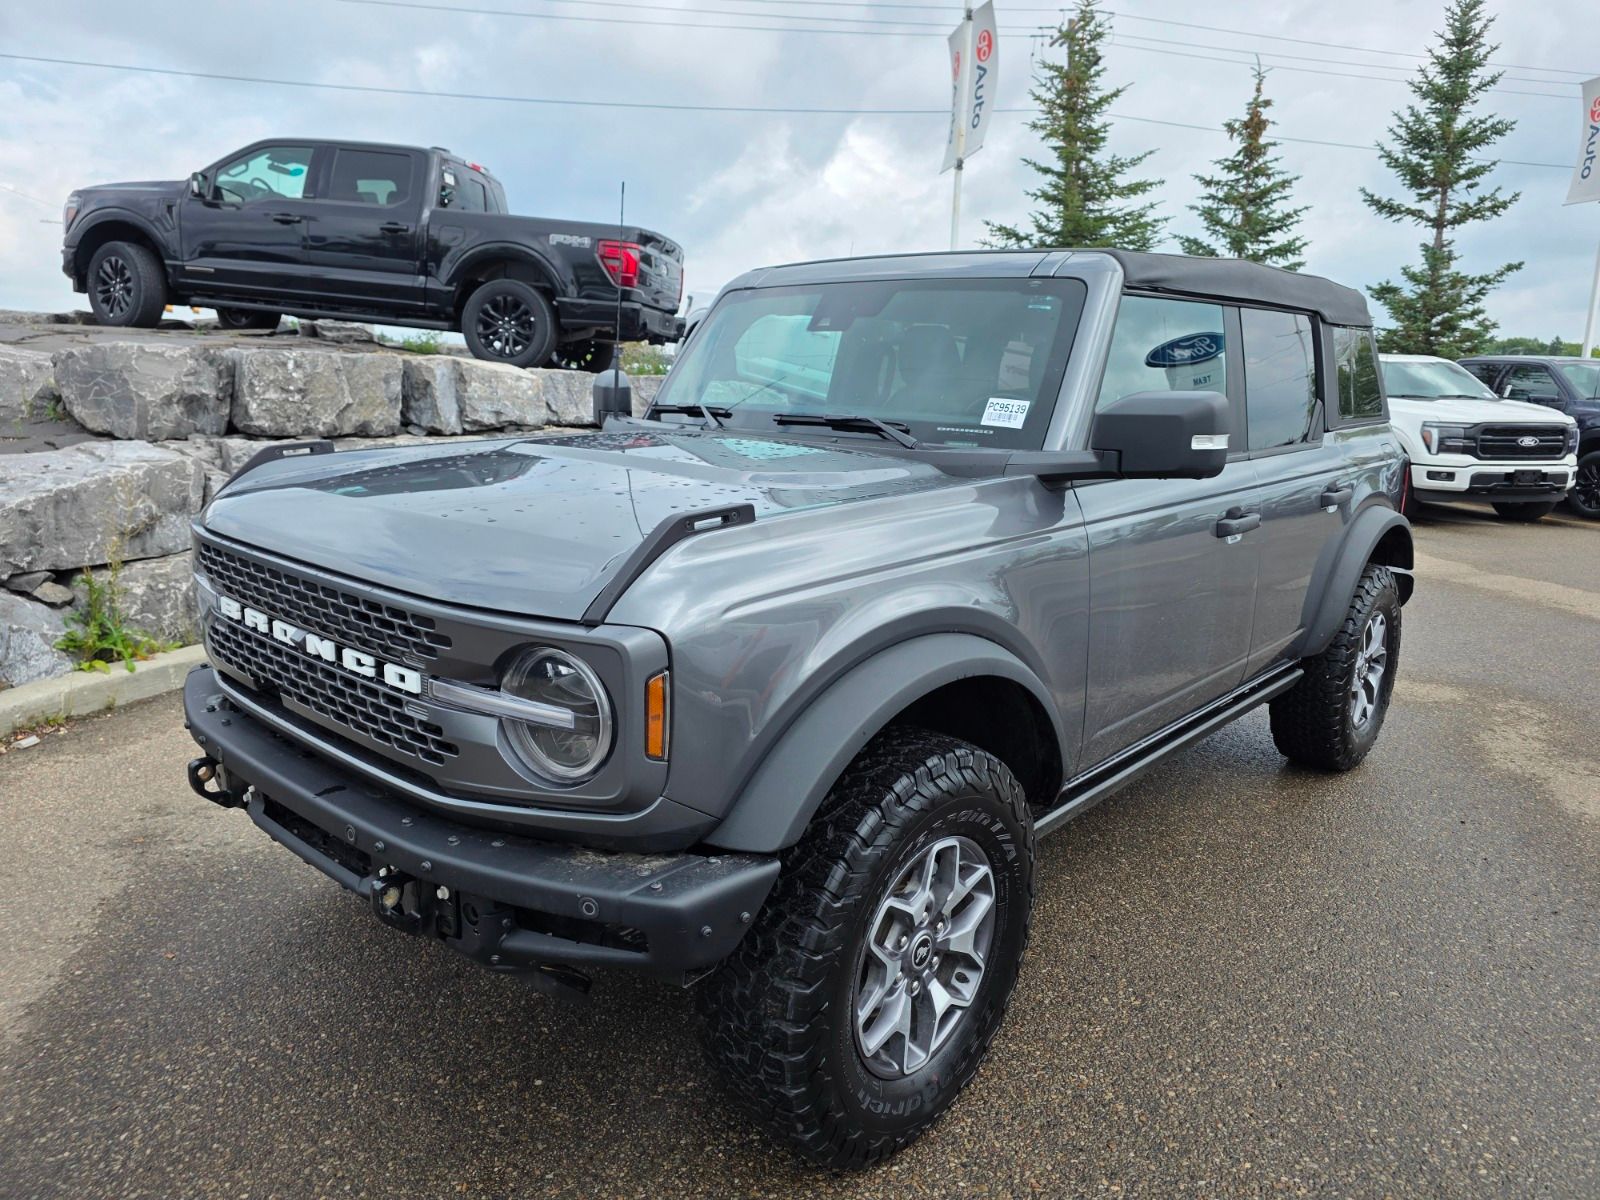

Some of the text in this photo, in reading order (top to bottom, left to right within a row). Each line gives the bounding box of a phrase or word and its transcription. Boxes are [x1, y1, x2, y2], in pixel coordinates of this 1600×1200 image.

[972, 30, 992, 129] go Auto
[1580, 124, 1600, 180] Auto
[987, 402, 1027, 415] PC95139
[220, 596, 422, 695] BRONCO
